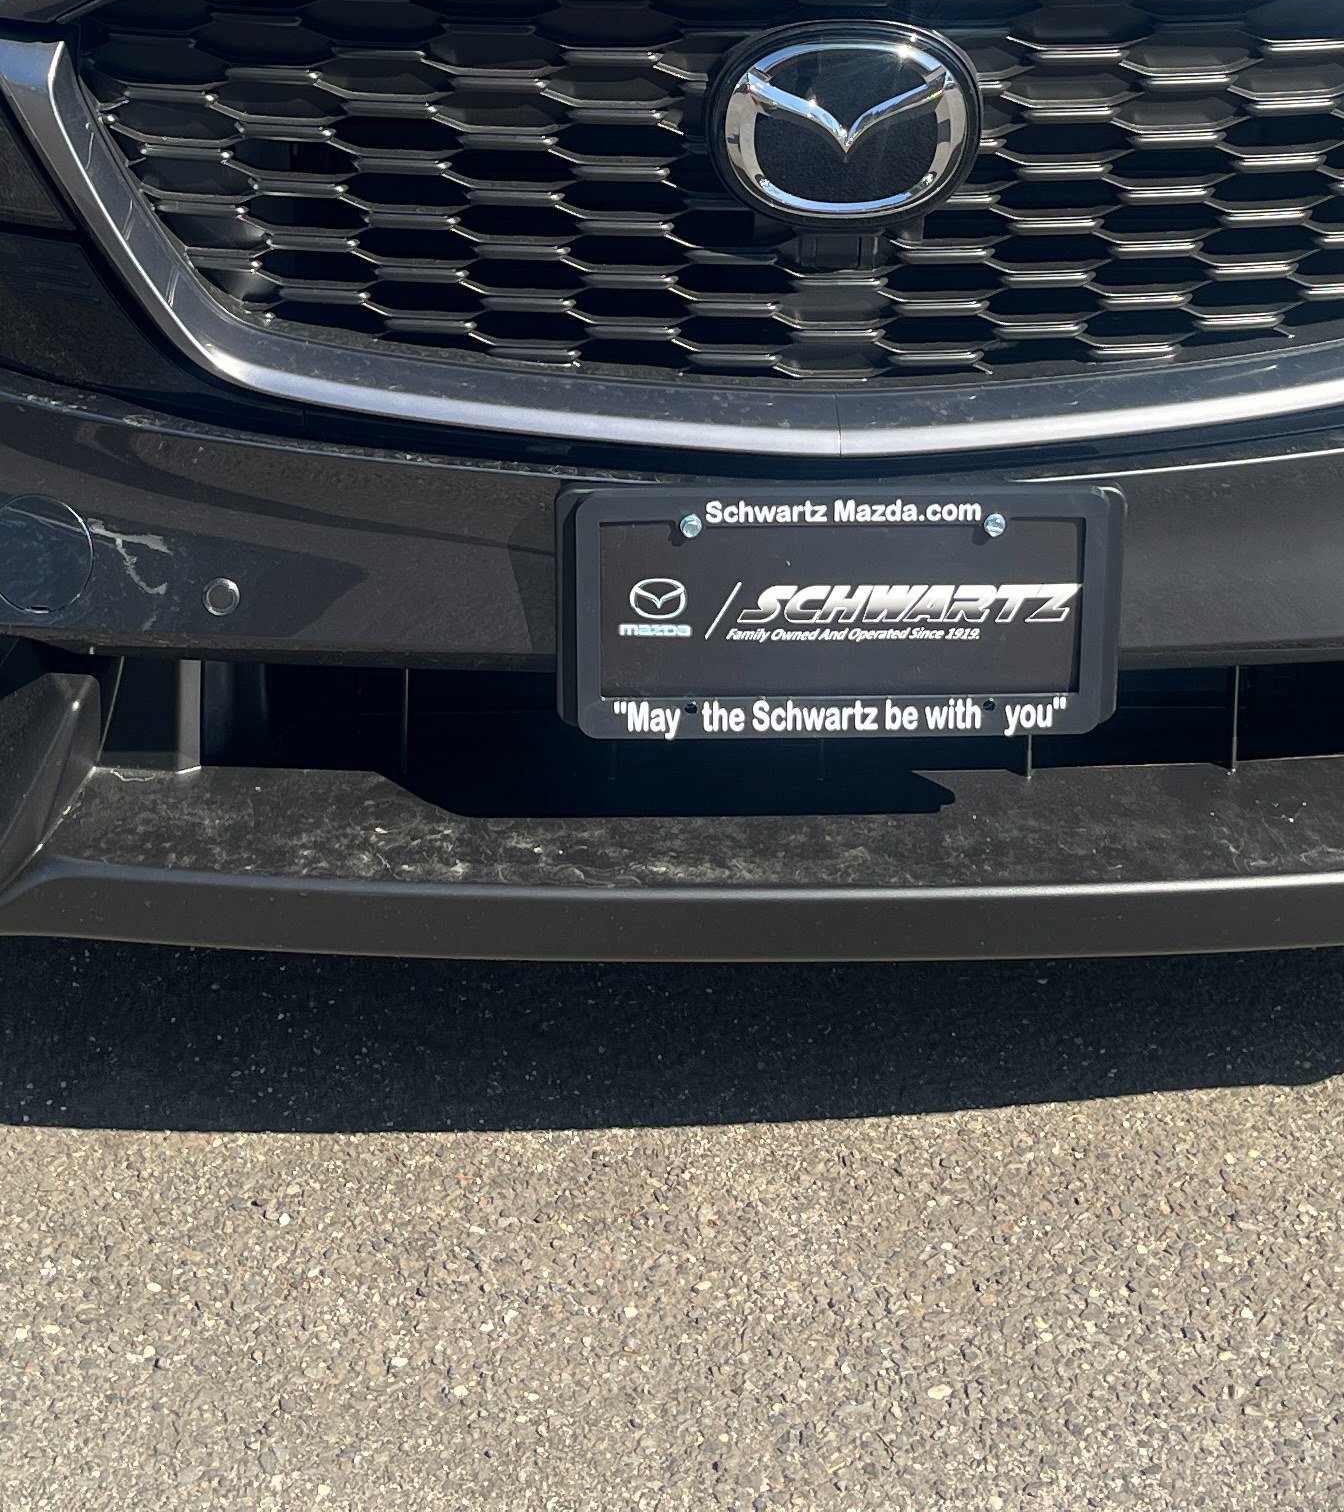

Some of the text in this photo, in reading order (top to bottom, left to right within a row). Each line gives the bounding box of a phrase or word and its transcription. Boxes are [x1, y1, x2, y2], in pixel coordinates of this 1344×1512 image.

[705, 499, 982, 524] Schwartz Mazda.com
[737, 582, 1083, 624] SCHWARTZ
[726, 628, 770, 643] Family
[771, 628, 817, 641] Owned
[818, 627, 846, 640] And
[848, 626, 907, 642] Operated
[908, 626, 945, 640] Since
[613, 697, 1067, 740] "May the Schwartz be with you"
